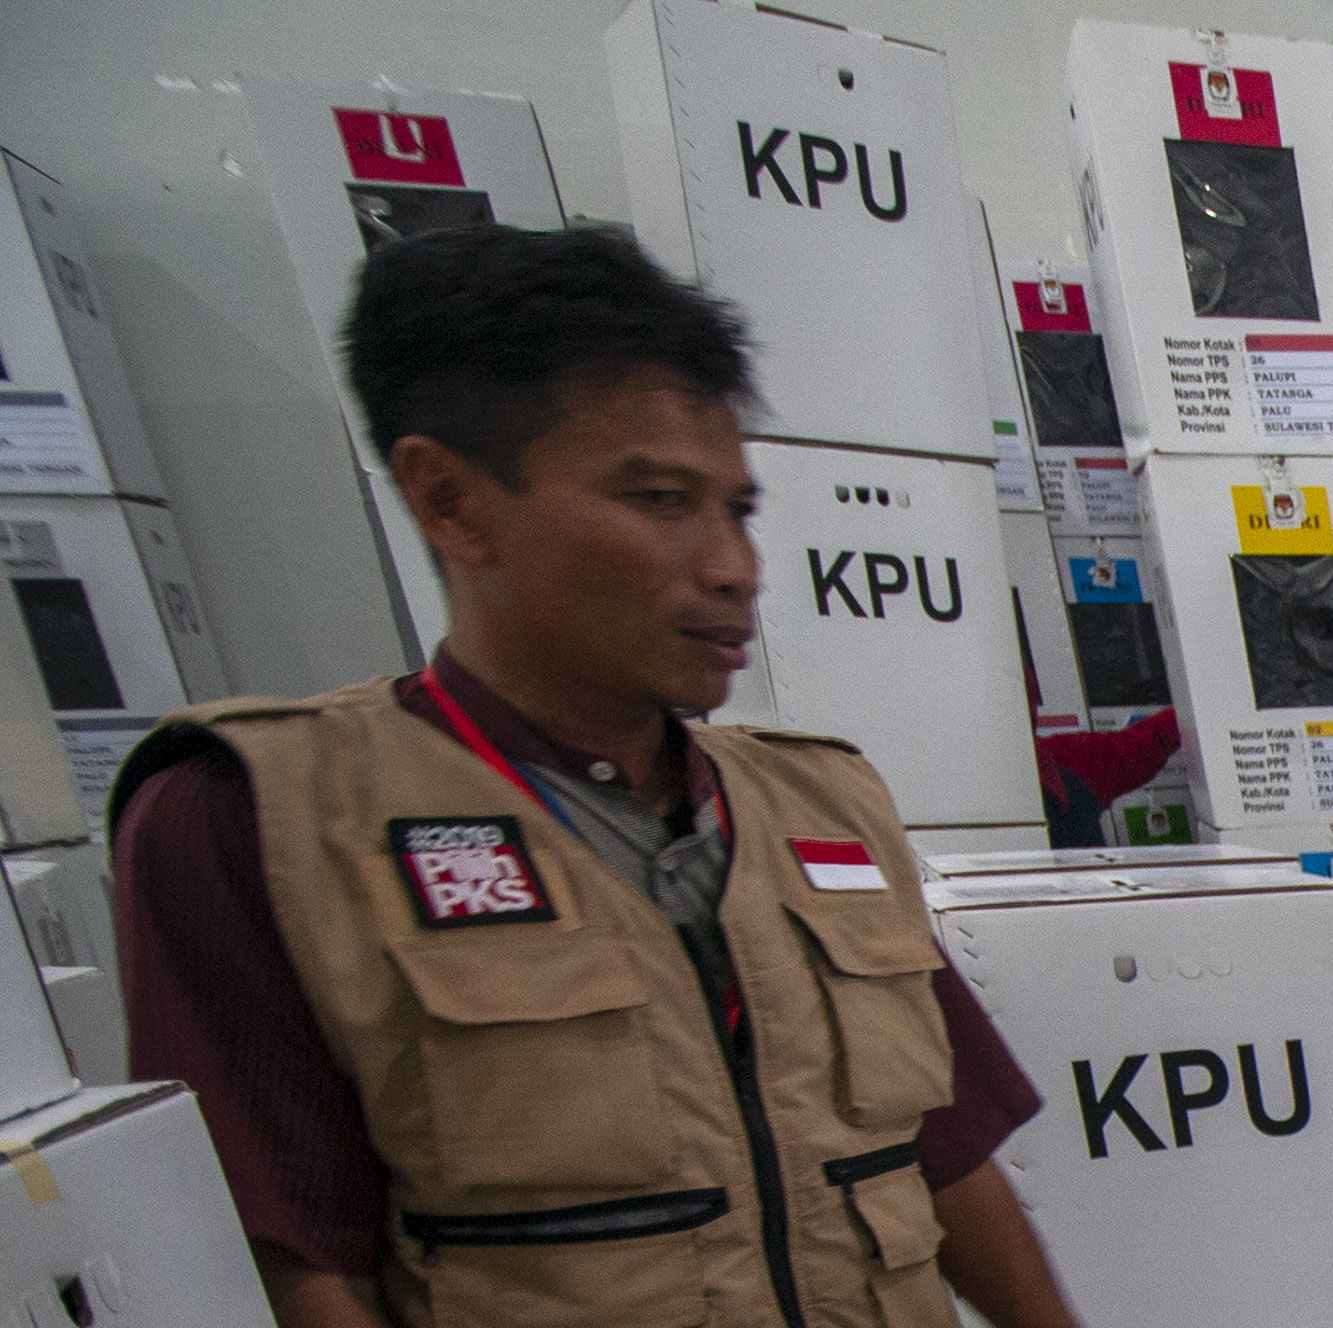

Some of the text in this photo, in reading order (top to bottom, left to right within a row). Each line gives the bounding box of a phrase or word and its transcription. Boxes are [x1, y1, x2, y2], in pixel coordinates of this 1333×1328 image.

[737, 120, 909, 224] KPU
[1164, 336, 1235, 351] Nomor Kotak
[1167, 354, 1204, 368] Nomor
[1206, 354, 1230, 367] TPS
[1170, 371, 1297, 384] Nama PPS PALUPI
[1174, 387, 1206, 400] Nama
[1208, 388, 1232, 401] PPK
[806, 547, 964, 624] KPU
[425, 878, 536, 920] PKS
[1070, 1039, 1314, 1161] KPU
